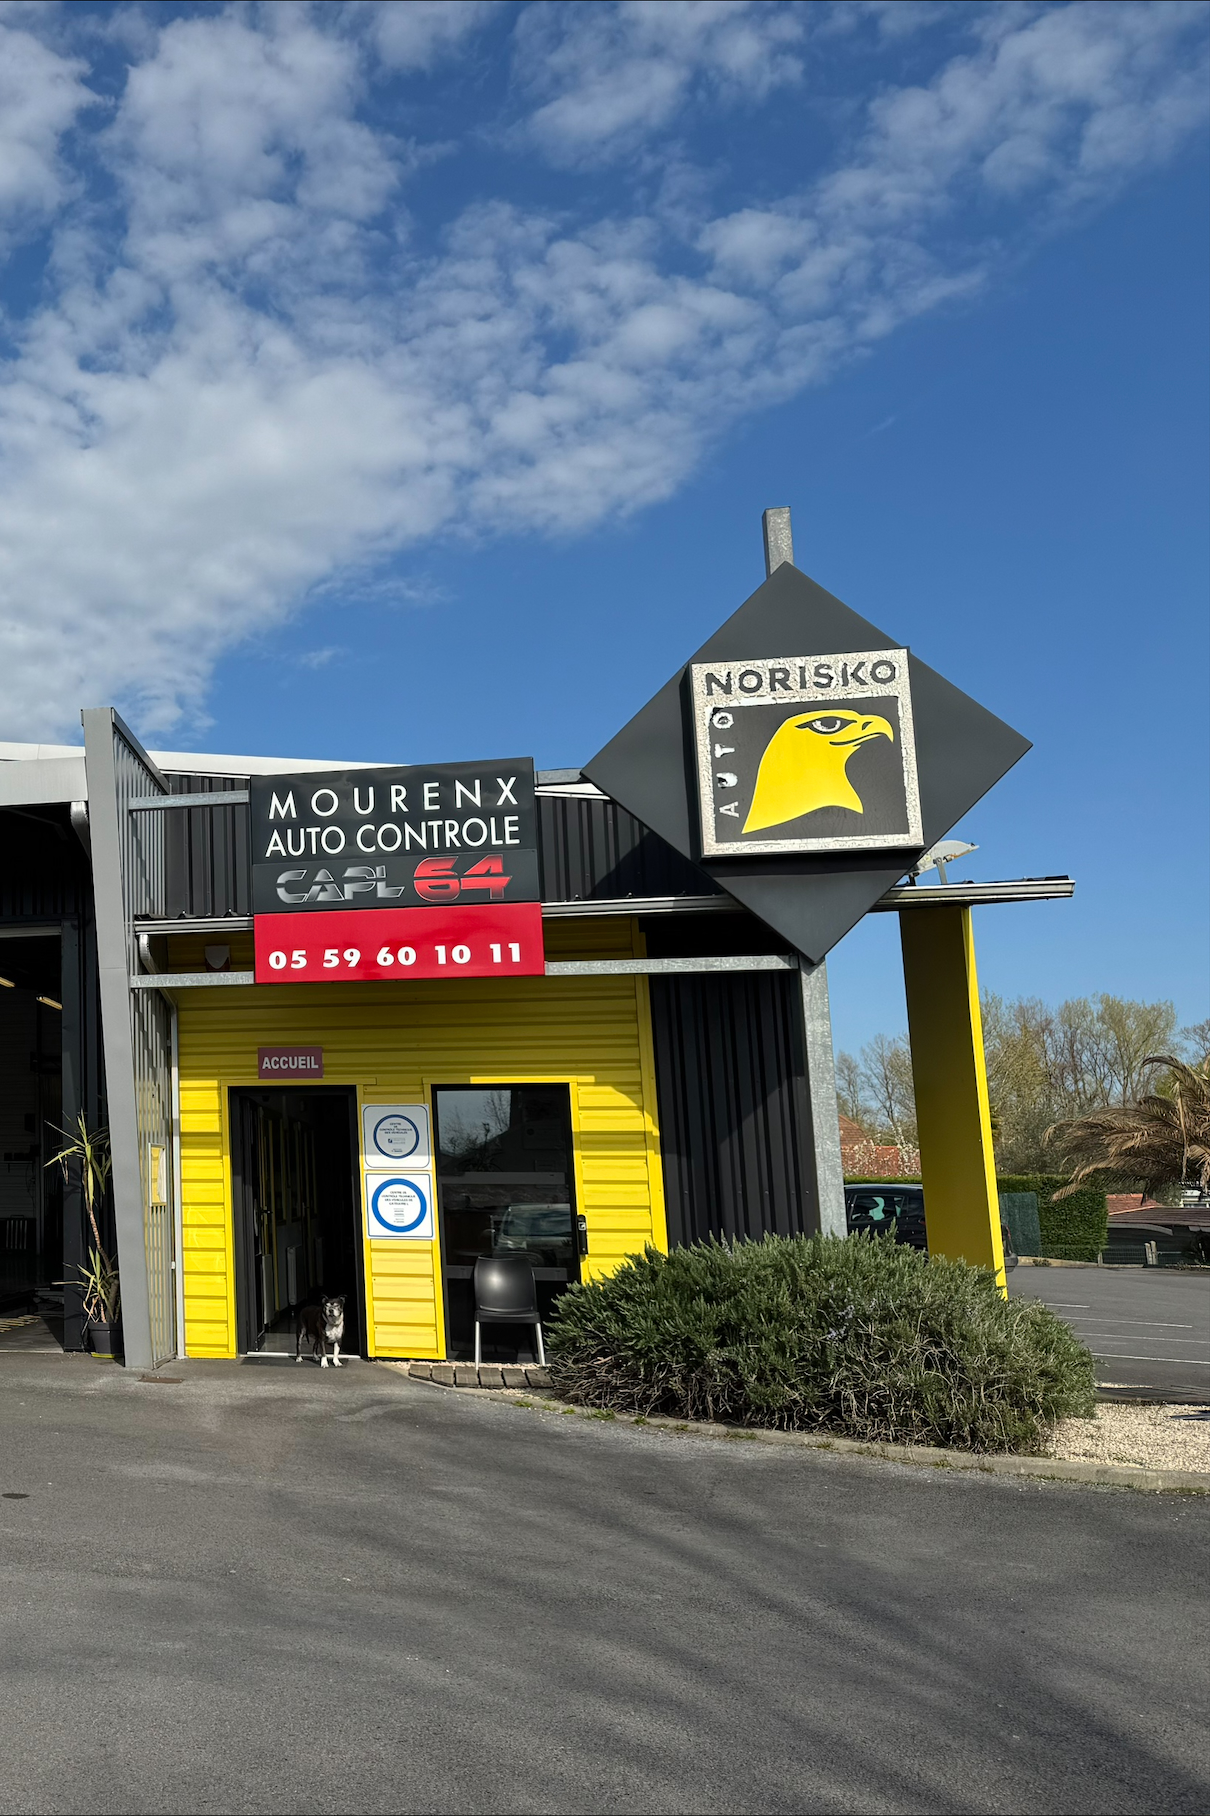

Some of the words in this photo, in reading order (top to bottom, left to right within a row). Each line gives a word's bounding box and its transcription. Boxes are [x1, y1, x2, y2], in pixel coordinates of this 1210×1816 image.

[705, 660, 896, 696] NORISKO
[712, 711, 739, 818] AUTO
[268, 776, 518, 820] MOURENX
[265, 826, 346, 857] AUTO
[356, 815, 520, 852] CONTROLE
[276, 865, 405, 904] CAPL
[413, 854, 512, 902] 64
[268, 949, 307, 970] 05
[322, 948, 361, 968] 59
[376, 945, 416, 966] 60
[435, 944, 471, 965] 10
[489, 942, 520, 963] 11
[262, 1056, 319, 1070] ACCUEIL
